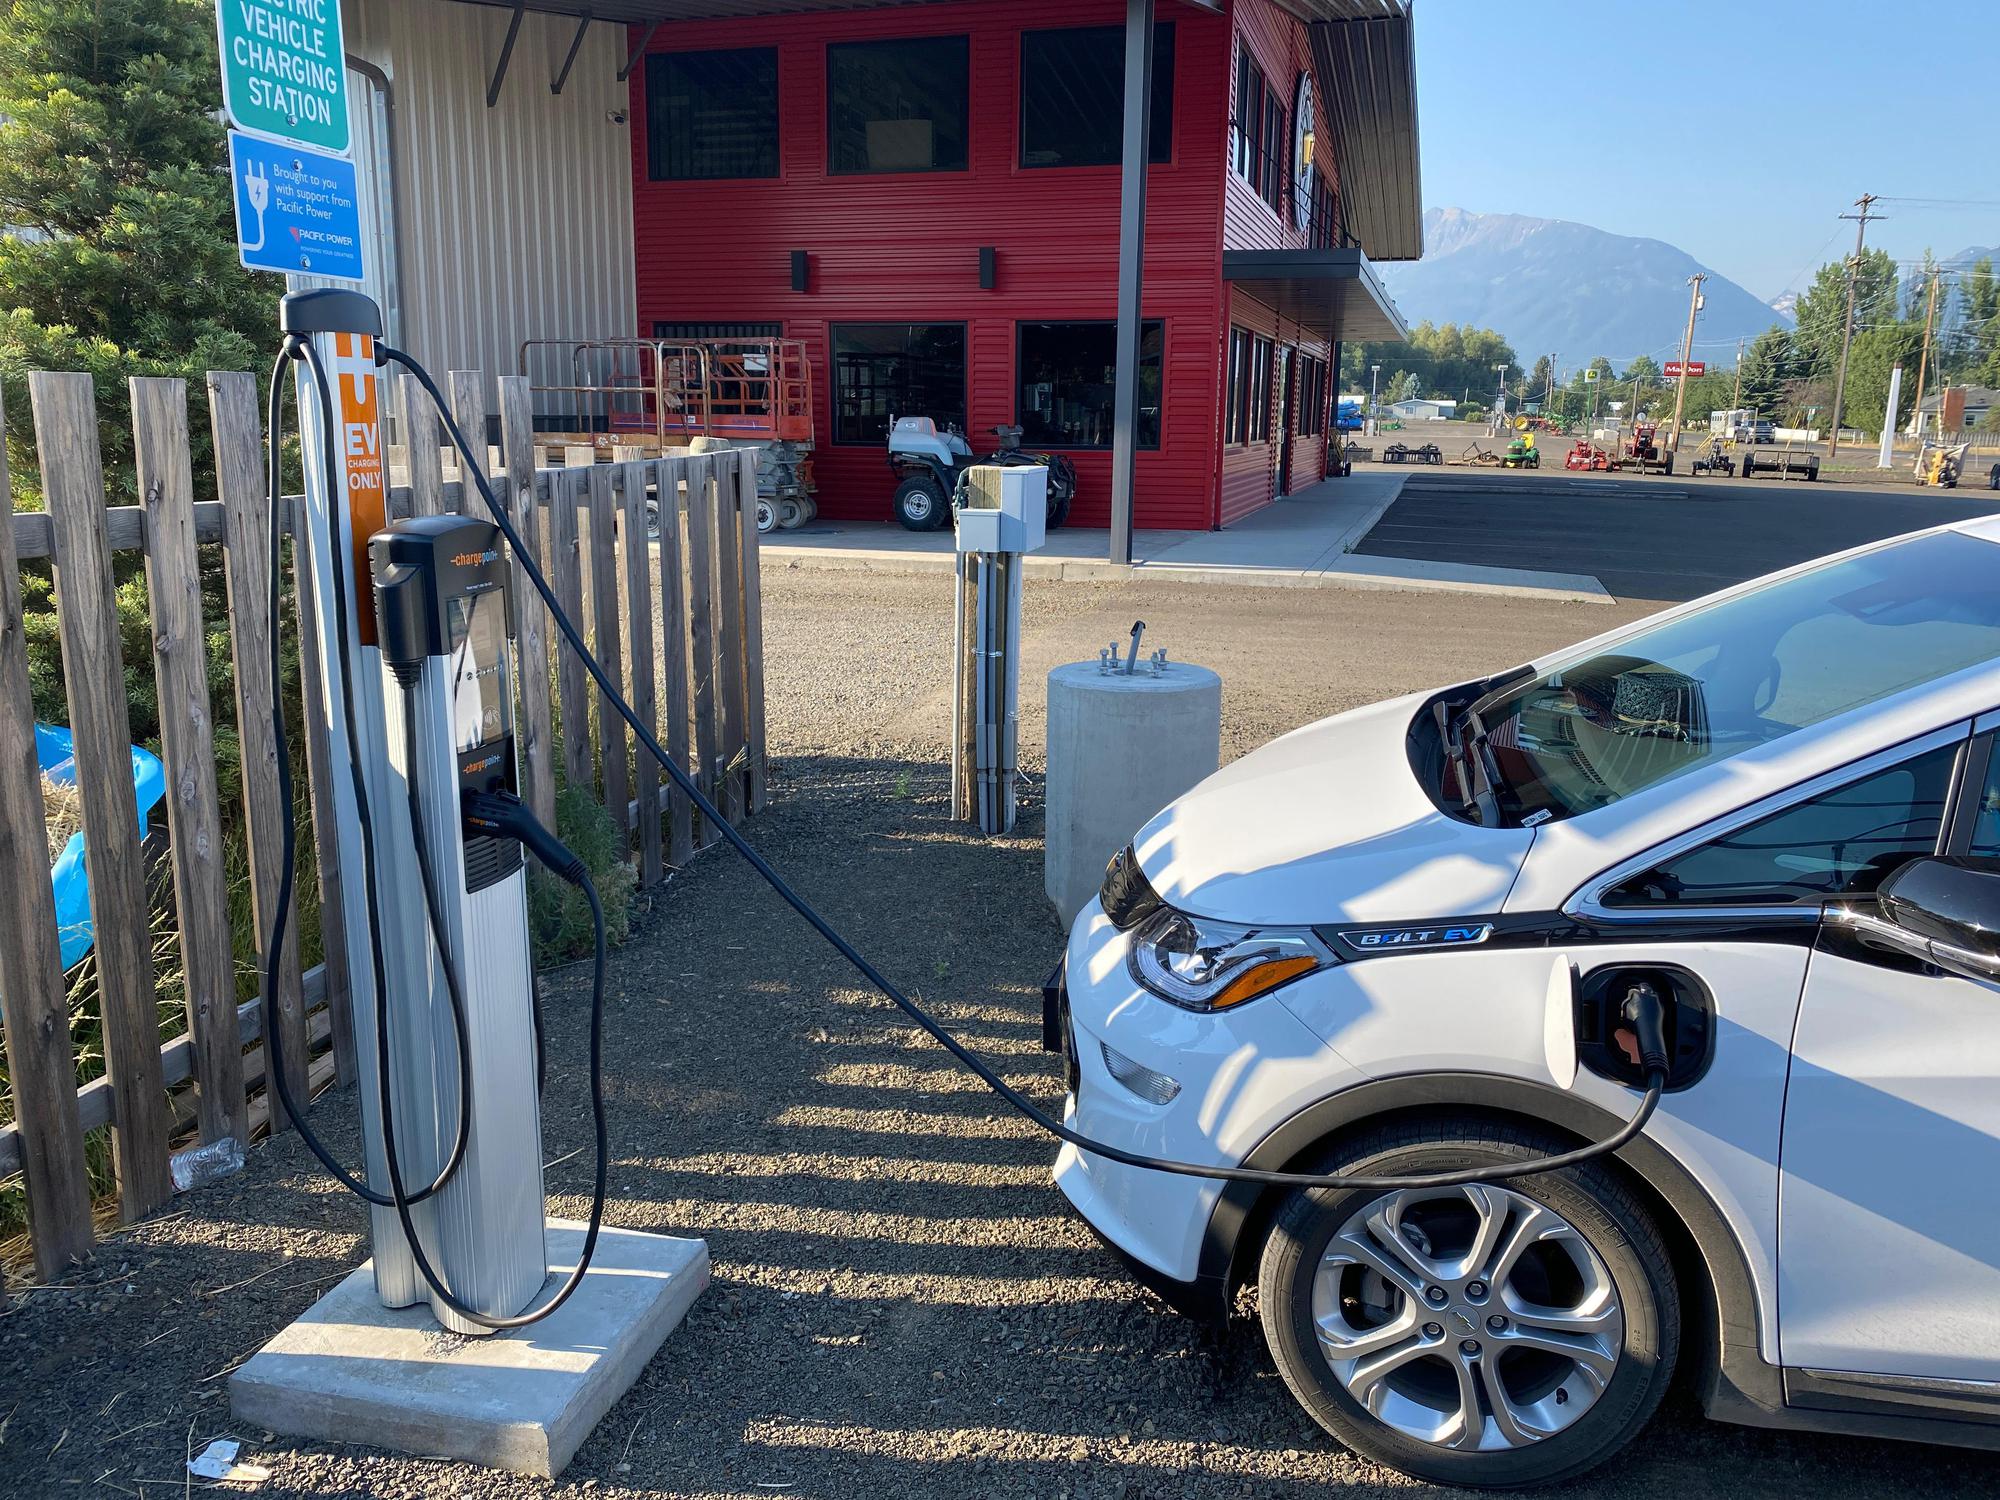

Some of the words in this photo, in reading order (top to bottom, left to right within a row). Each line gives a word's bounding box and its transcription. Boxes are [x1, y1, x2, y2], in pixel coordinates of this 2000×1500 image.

[258, 0, 326, 24] RIC
[240, 1, 327, 58] VEHICLE
[233, 36, 337, 94] CHARGING
[249, 76, 331, 126] STATION
[273, 163, 308, 185] Brought
[310, 175, 320, 185] to
[322, 178, 337, 190] you
[274, 183, 294, 196] with
[297, 189, 330, 204] support
[331, 193, 351, 208] from
[276, 198, 304, 215] Pacific
[306, 204, 333, 220] Power
[299, 229, 325, 242] PACIFIC
[326, 233, 353, 246] POWER
[345, 422, 377, 455] EV
[348, 459, 380, 468] CHARGING
[349, 472, 380, 490] ONLY
[451, 548, 498, 567] chargepoint
[1361, 931, 1435, 945] BOLT
[1444, 928, 1480, 940] EV
